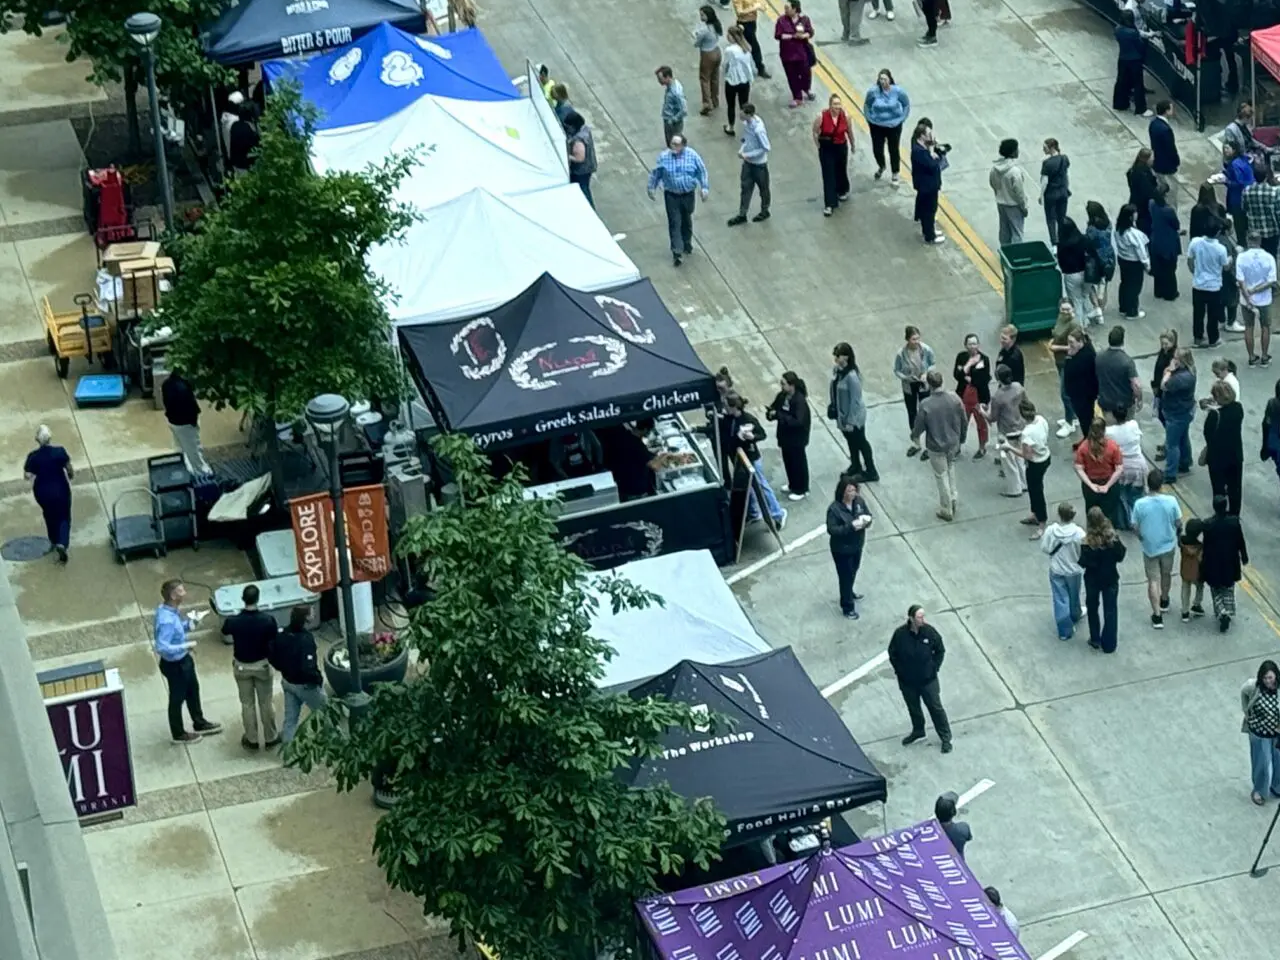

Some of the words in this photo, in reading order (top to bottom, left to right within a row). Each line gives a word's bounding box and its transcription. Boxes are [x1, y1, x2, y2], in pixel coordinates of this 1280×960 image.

[281, 32, 314, 54] BITTER
[315, 33, 324, 47] &
[325, 26, 352, 44] POUR
[472, 429, 514, 447] Gyros
[535, 412, 577, 434] Greek
[578, 404, 621, 421] Salads
[643, 391, 700, 412] Chicken
[298, 502, 324, 588] EXPLORE
[662, 747, 686, 761] The
[689, 730, 755, 753] Workshop
[737, 816, 773, 834] Food
[778, 808, 807, 823] Hall
[826, 796, 851, 809] Bar
[932, 854, 967, 885] LUMI
[704, 875, 762, 898] LUMI
[917, 878, 951, 910] LUMI
[690, 903, 723, 938] LUMI
[735, 901, 763, 940] LUMI
[769, 889, 800, 933] LUMI
[824, 897, 884, 932] LUMI
[961, 898, 998, 929] LUMI
[887, 922, 938, 950] LUM
